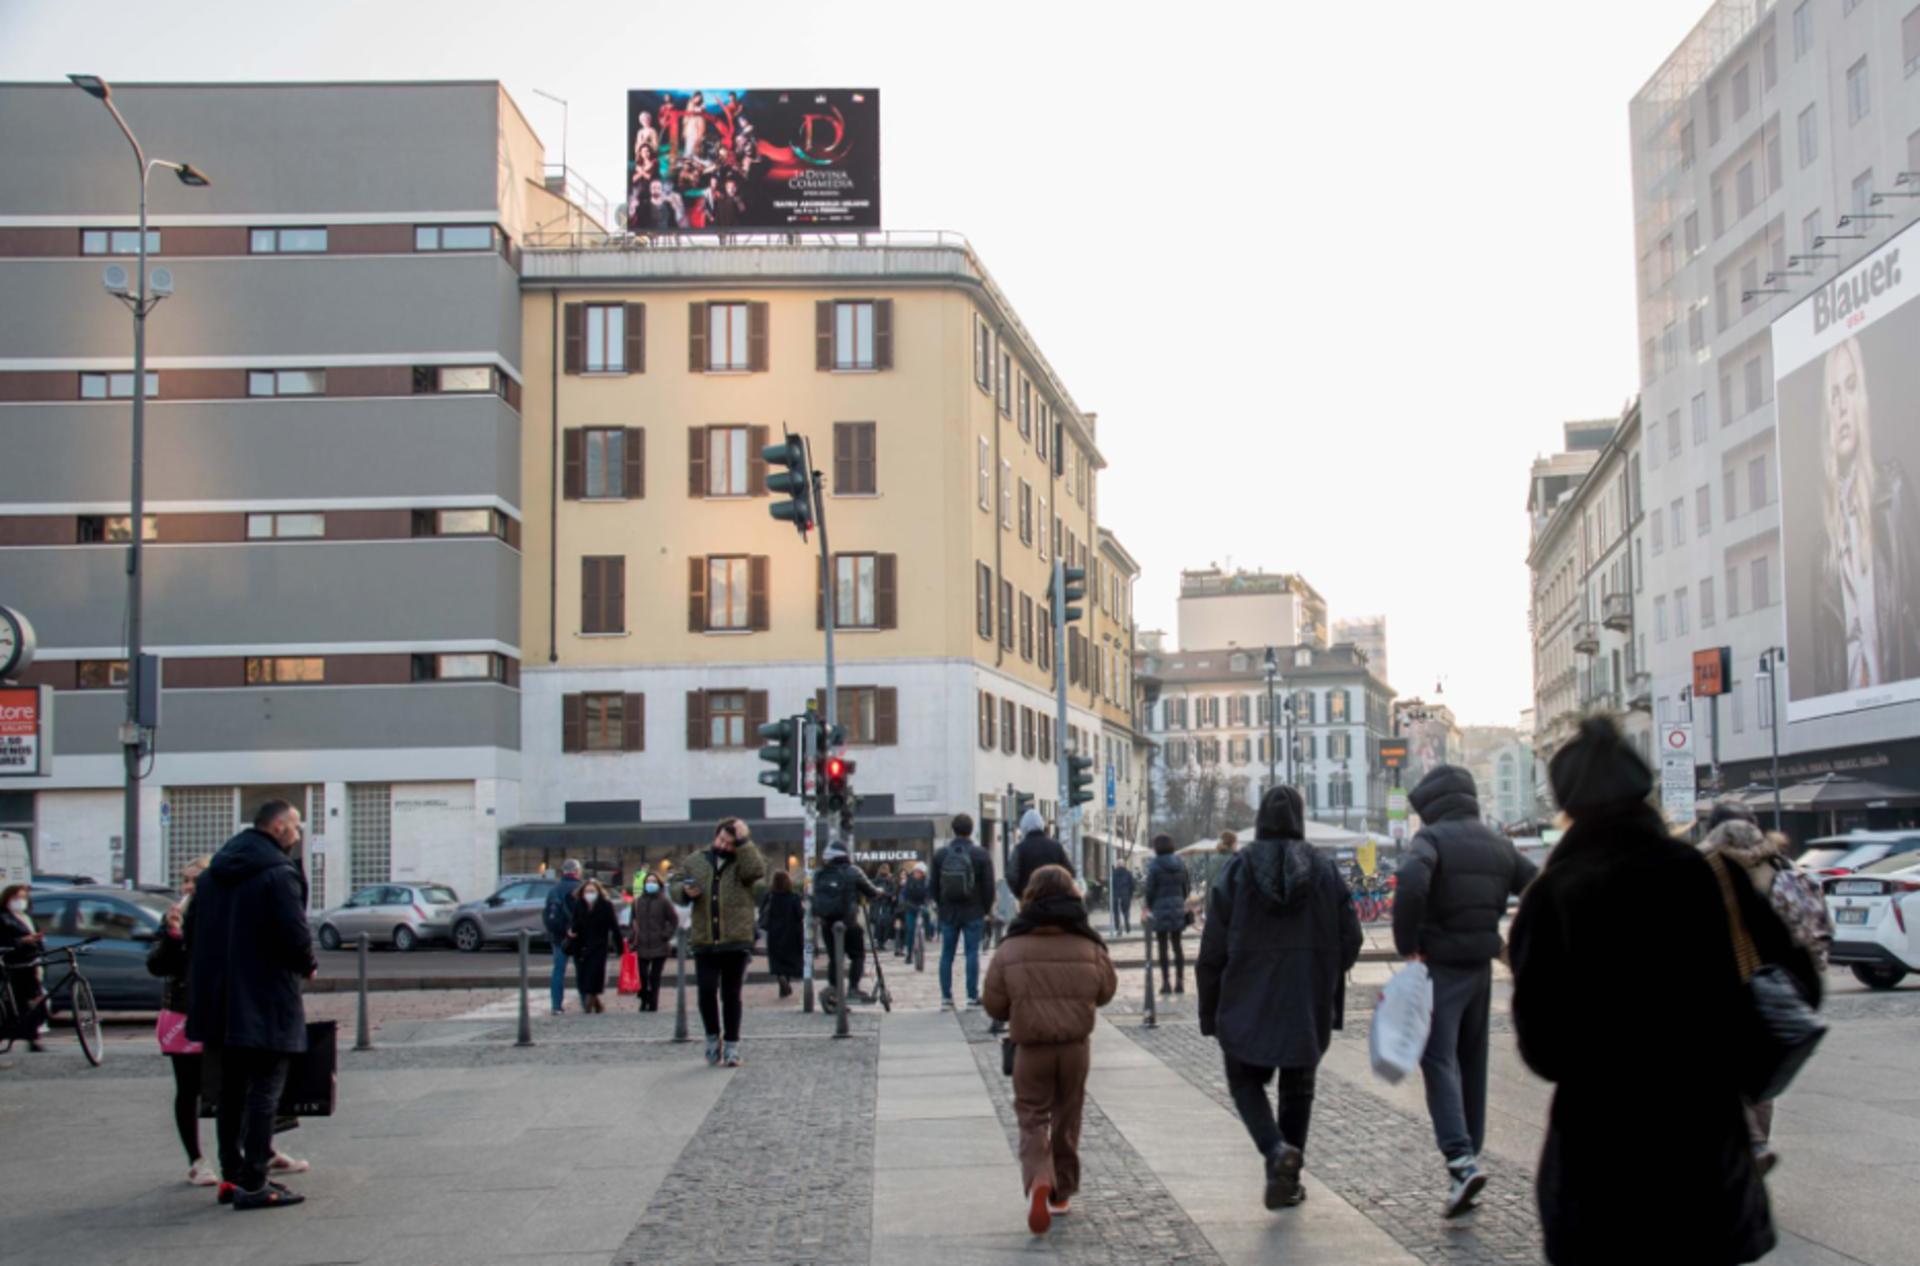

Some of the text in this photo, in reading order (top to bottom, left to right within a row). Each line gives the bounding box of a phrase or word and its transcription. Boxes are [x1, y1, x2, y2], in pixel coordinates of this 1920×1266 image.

[788, 178, 854, 189] COMMEDIA
[1695, 664, 1719, 680] TAXI
[854, 850, 917, 861] TARBUCKS
